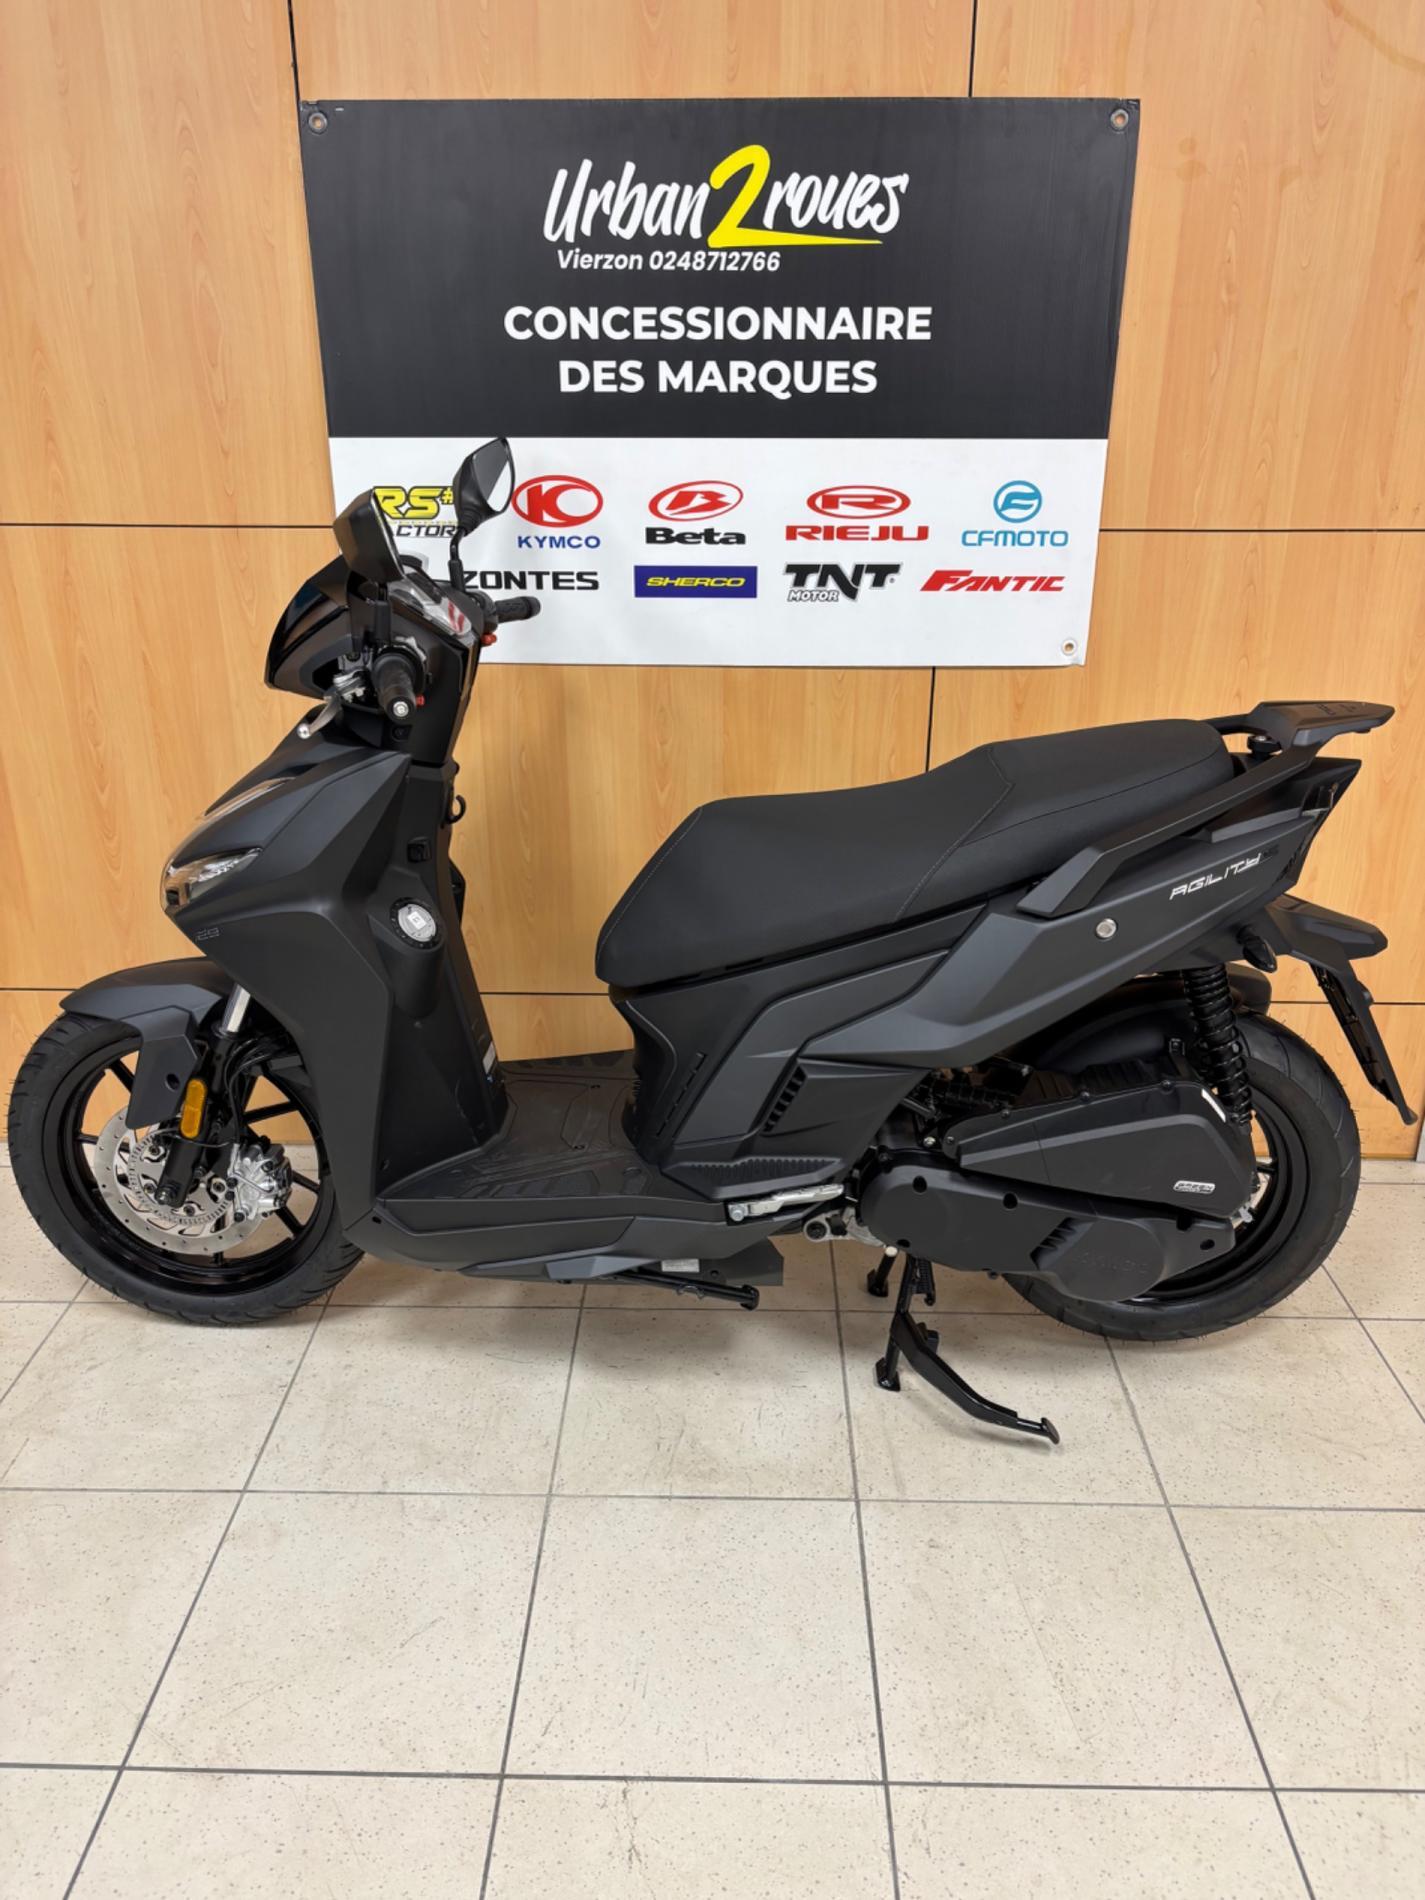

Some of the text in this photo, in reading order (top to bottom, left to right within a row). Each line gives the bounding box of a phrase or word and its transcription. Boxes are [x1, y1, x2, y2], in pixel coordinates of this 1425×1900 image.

[557, 249, 781, 272] Vierzon 0248712766
[504, 306, 932, 341] CONCESSIONNAIRE
[559, 360, 878, 400] DES MARQUES
[518, 536, 600, 549] KYMCO
[645, 527, 746, 545] Beta
[785, 525, 929, 541] RIEJU
[961, 530, 1069, 547] CFMOTO
[463, 570, 599, 591] ZONTES
[646, 576, 746, 587] SHERCO
[920, 570, 1065, 592] FANTIC
[787, 589, 839, 602] MOTOR
[1169, 852, 1262, 900] AGILITY
